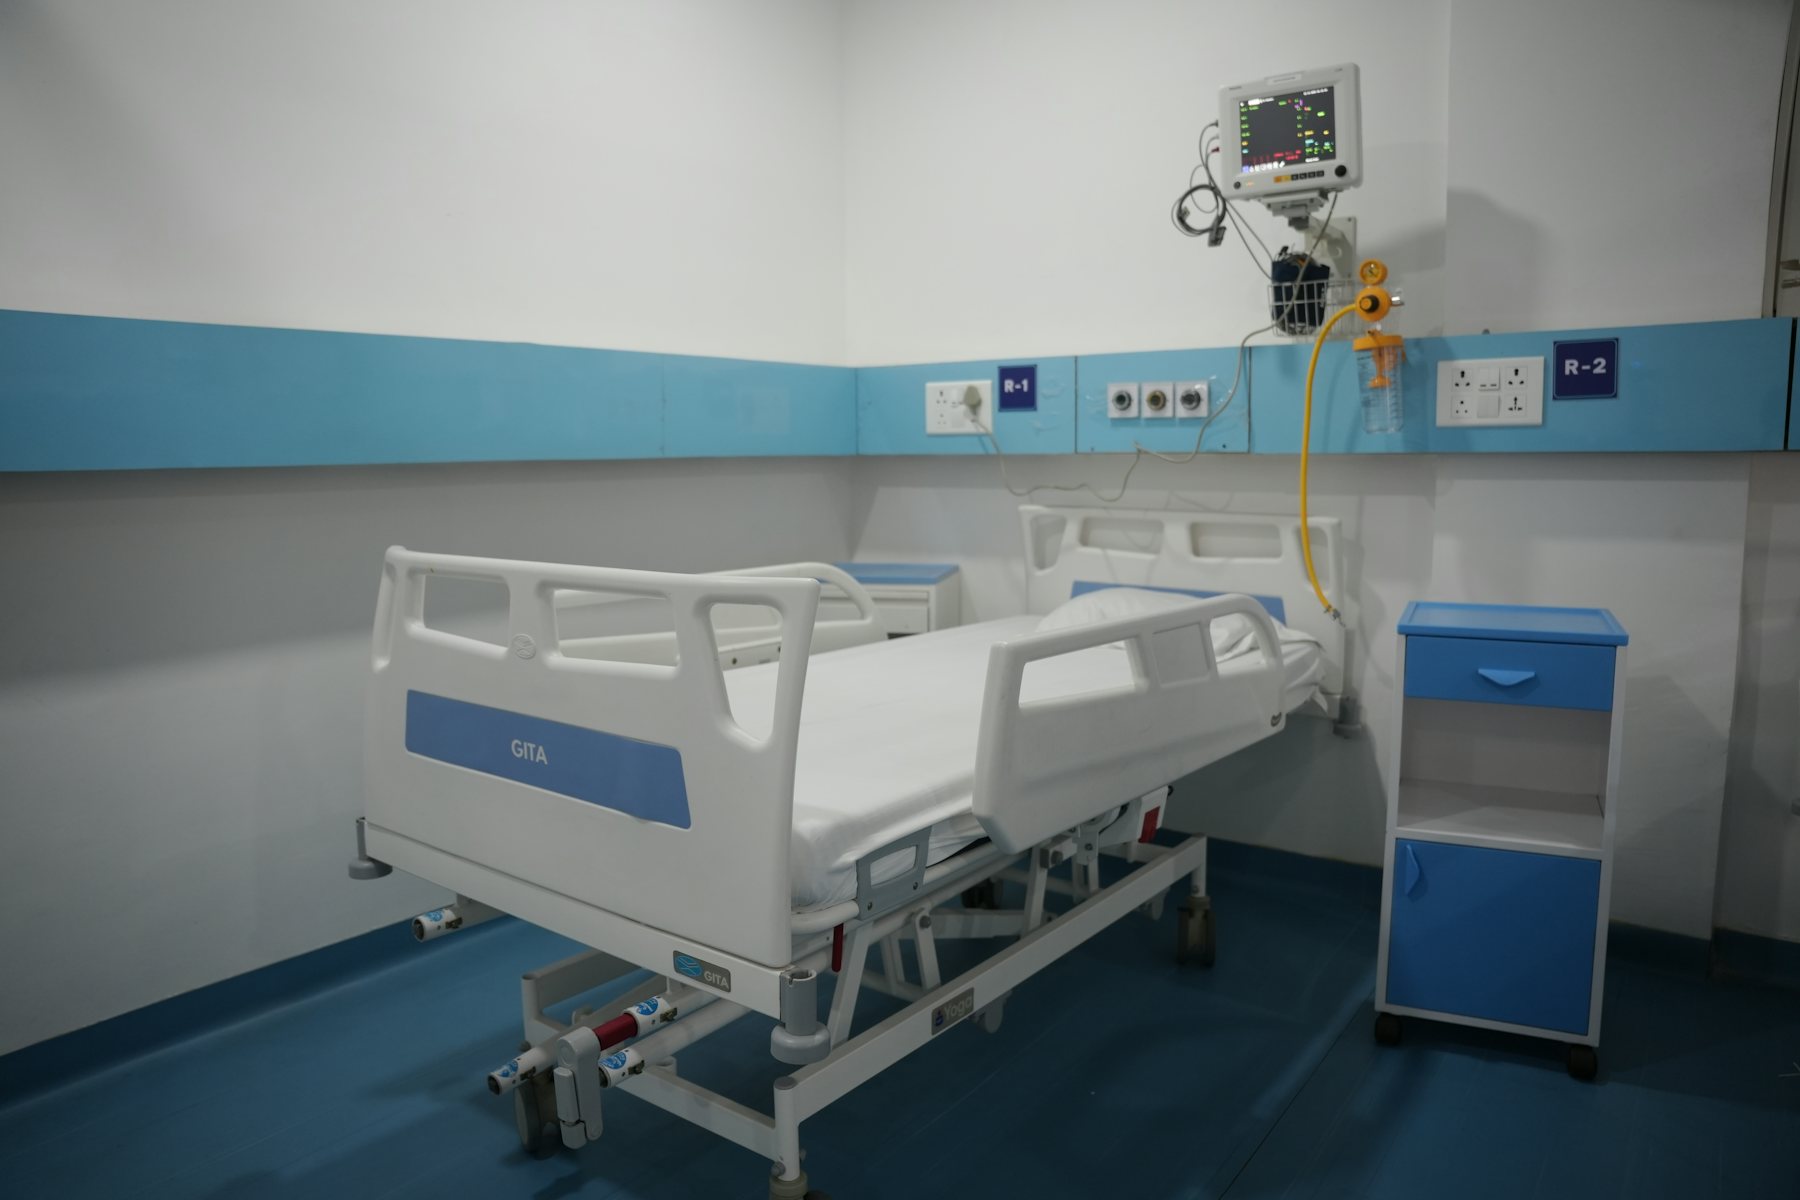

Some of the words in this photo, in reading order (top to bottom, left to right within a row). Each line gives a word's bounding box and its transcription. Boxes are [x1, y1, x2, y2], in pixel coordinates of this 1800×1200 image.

[1564, 357, 1607, 376] R-2
[1003, 379, 1029, 393] R-1
[511, 739, 548, 765] GITA
[704, 971, 729, 989] GITA
[944, 996, 972, 1021] Yoga
